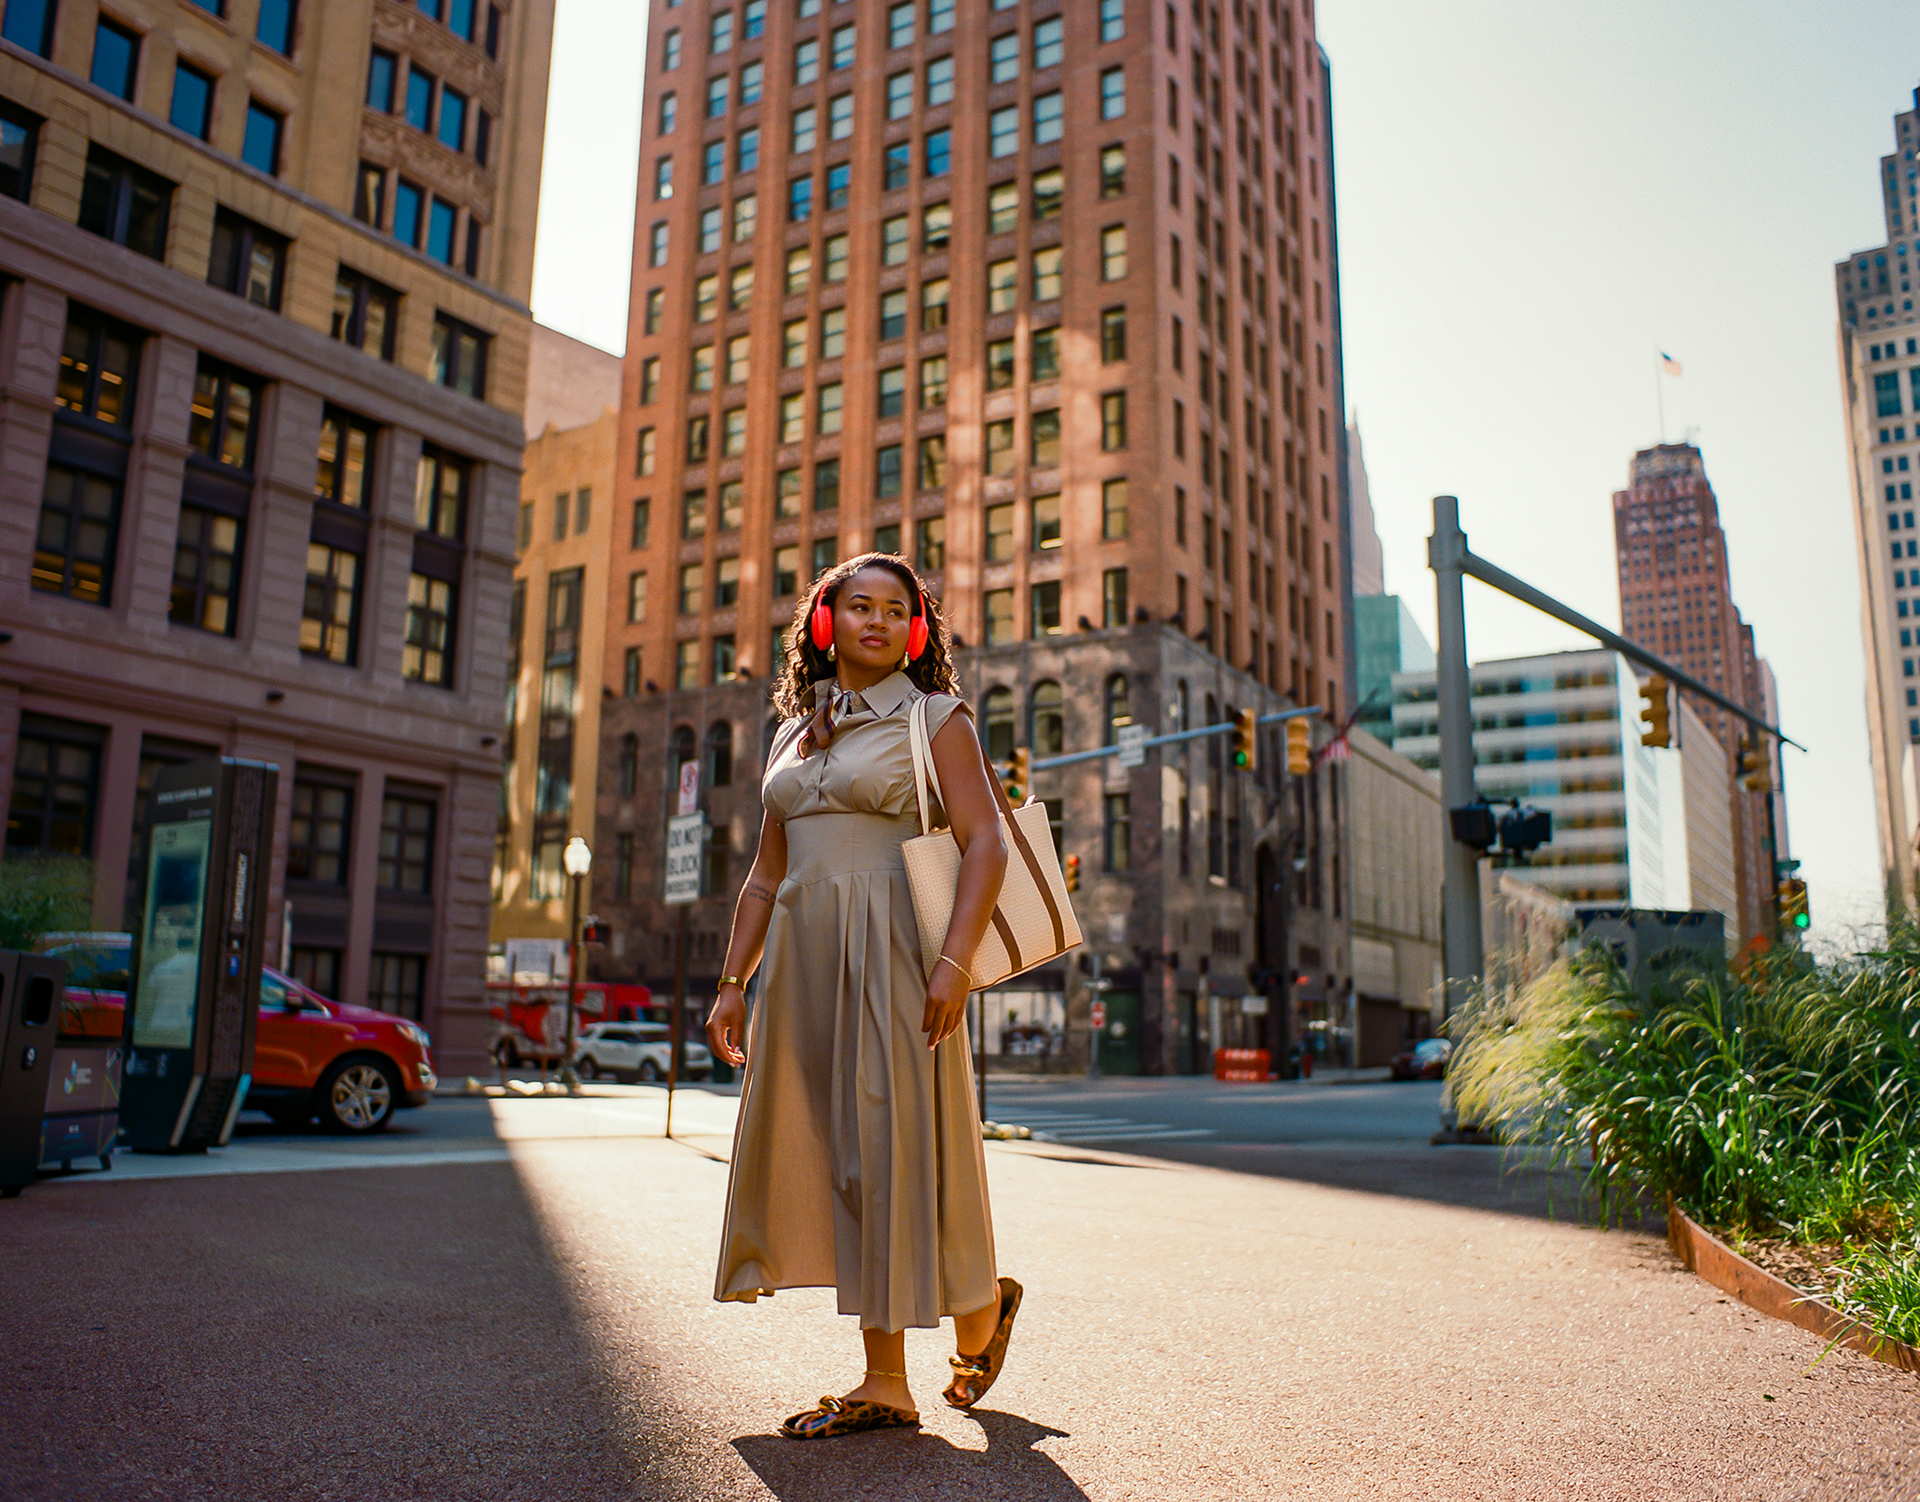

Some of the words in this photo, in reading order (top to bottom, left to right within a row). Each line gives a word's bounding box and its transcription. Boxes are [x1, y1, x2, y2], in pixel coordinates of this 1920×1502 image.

[669, 829, 682, 849] DO
[684, 824, 701, 846] NOT
[667, 854, 700, 876] BLOCK
[234, 852, 249, 922] EMERGENCY
